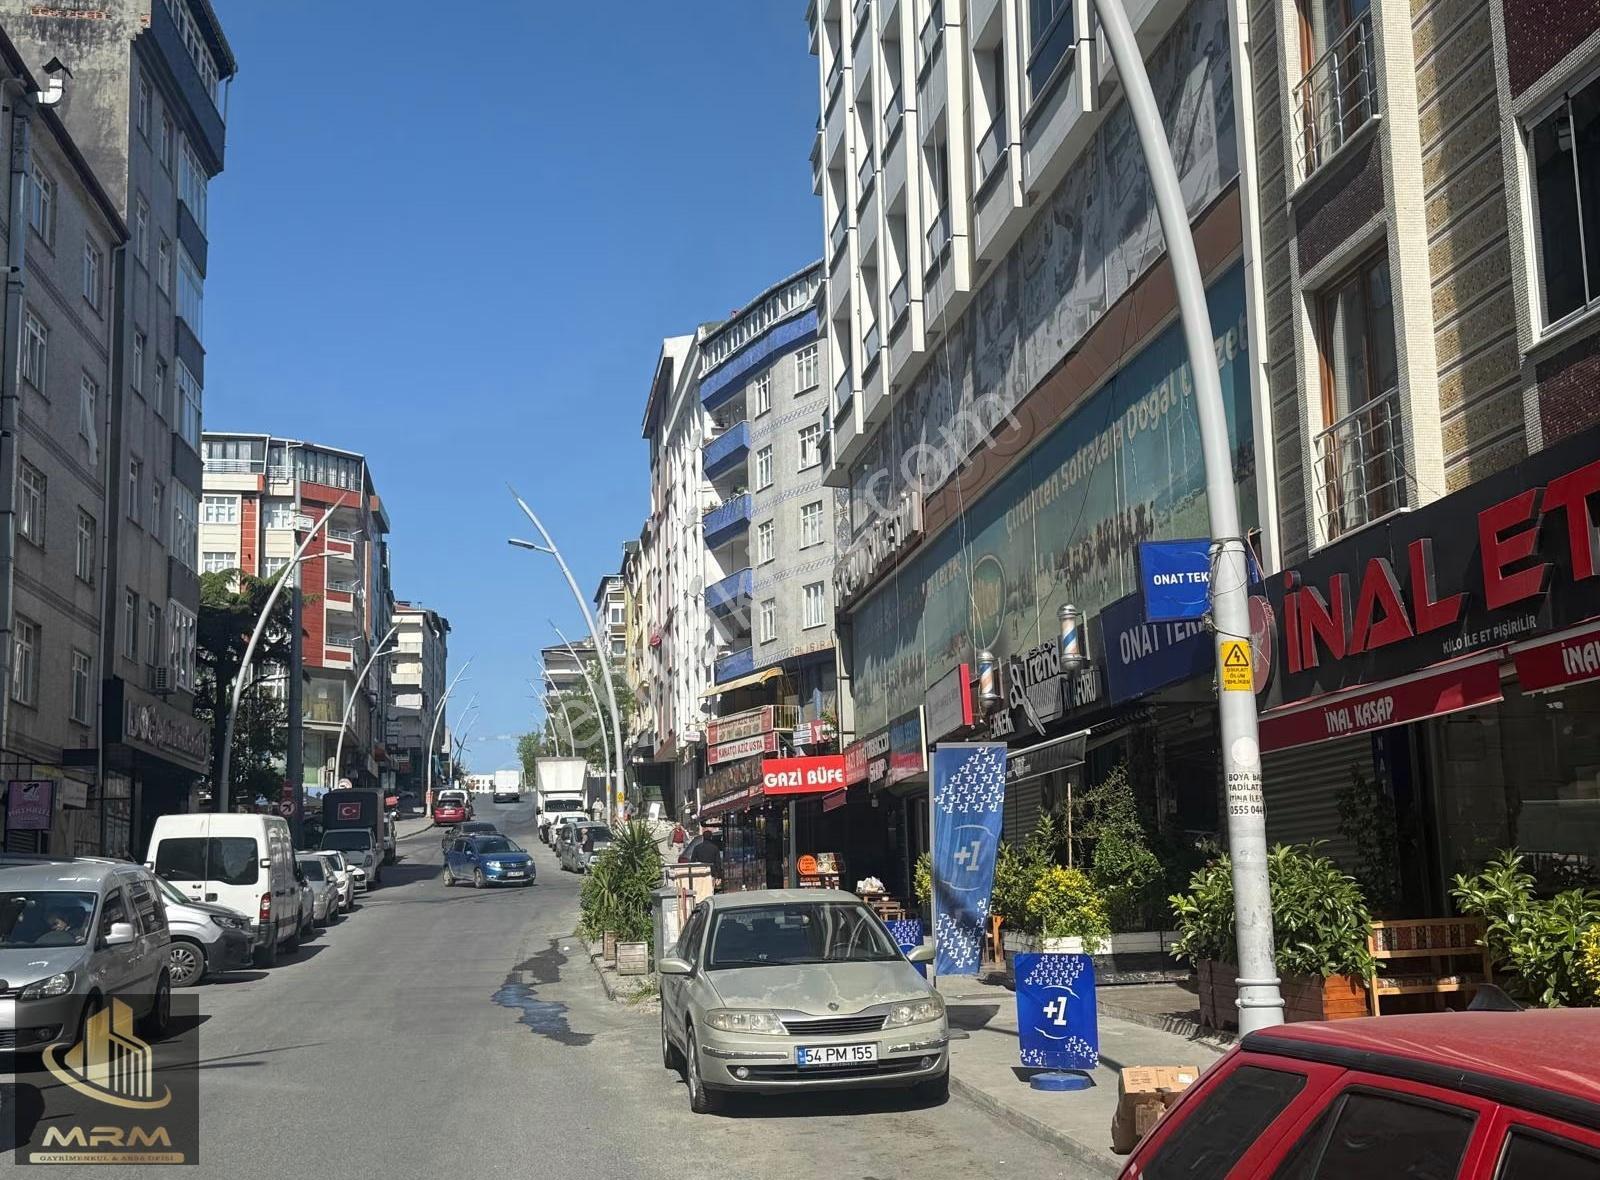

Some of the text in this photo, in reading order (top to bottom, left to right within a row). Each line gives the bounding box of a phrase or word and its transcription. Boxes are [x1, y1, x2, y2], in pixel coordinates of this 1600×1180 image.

[1153, 571, 1210, 585] ONAT TEK
[1284, 538, 1468, 673] İNAL
[1120, 624, 1160, 665] ONAT
[1464, 632, 1478, 648] İLE
[1480, 629, 1491, 643] ET
[1022, 648, 1061, 686] Trend
[1324, 696, 1394, 734] İNAL KASAP
[764, 768, 803, 788] GAZİ
[807, 766, 843, 785] BÜFE
[1228, 773, 1249, 782] BOYA
[1229, 783, 1262, 791] TADİLAT
[1230, 806, 1249, 815] 0555
[953, 841, 981, 871] +1
[1042, 996, 1067, 1026] +1
[805, 1046, 873, 1062] 54 PM 155
